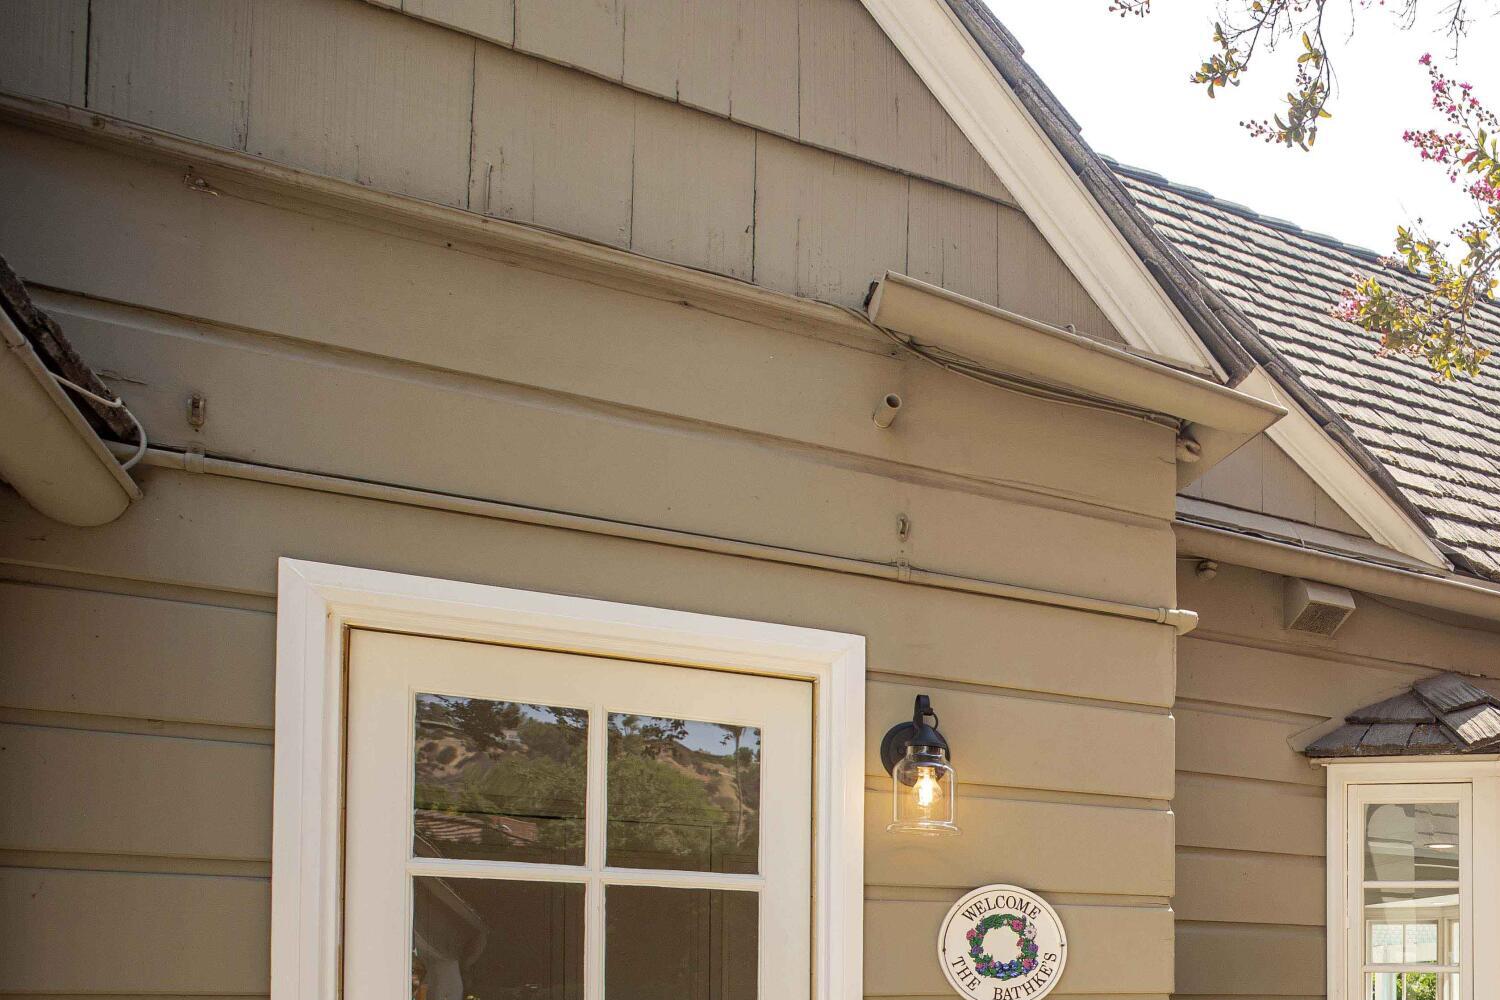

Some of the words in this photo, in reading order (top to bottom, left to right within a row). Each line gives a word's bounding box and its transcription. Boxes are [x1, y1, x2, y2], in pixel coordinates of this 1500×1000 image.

[961, 895, 1042, 922] WELCOME
[951, 956, 981, 991] THE
[993, 952, 1057, 1000] BATHKE'S
